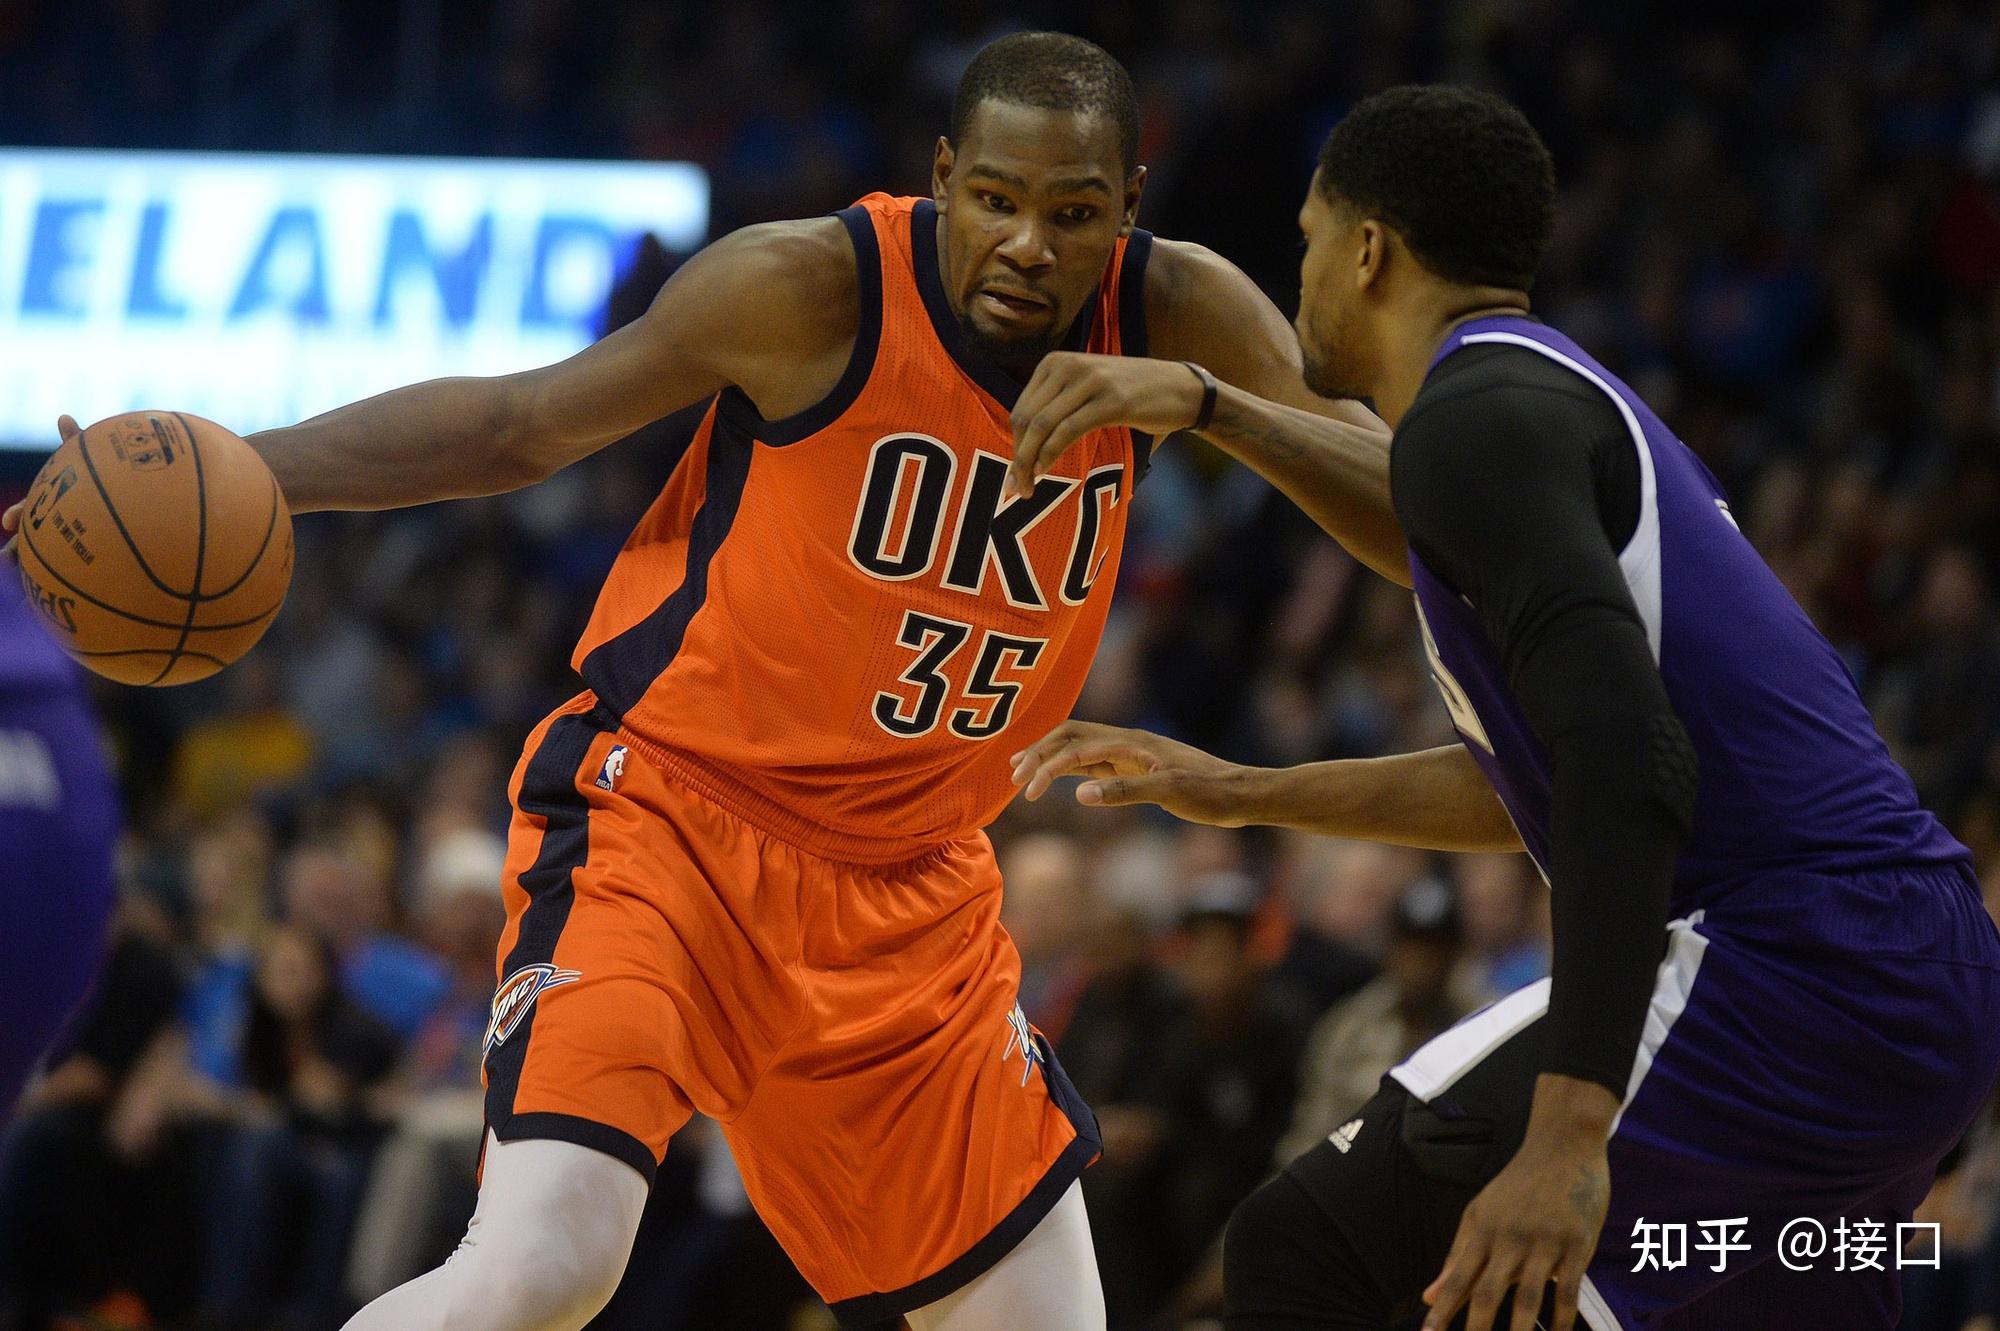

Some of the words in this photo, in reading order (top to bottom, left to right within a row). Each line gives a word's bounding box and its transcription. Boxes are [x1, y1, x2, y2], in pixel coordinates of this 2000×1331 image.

[847, 432, 1123, 611] OKC
[871, 609, 1049, 740] 35
[595, 778, 611, 790] NBA
